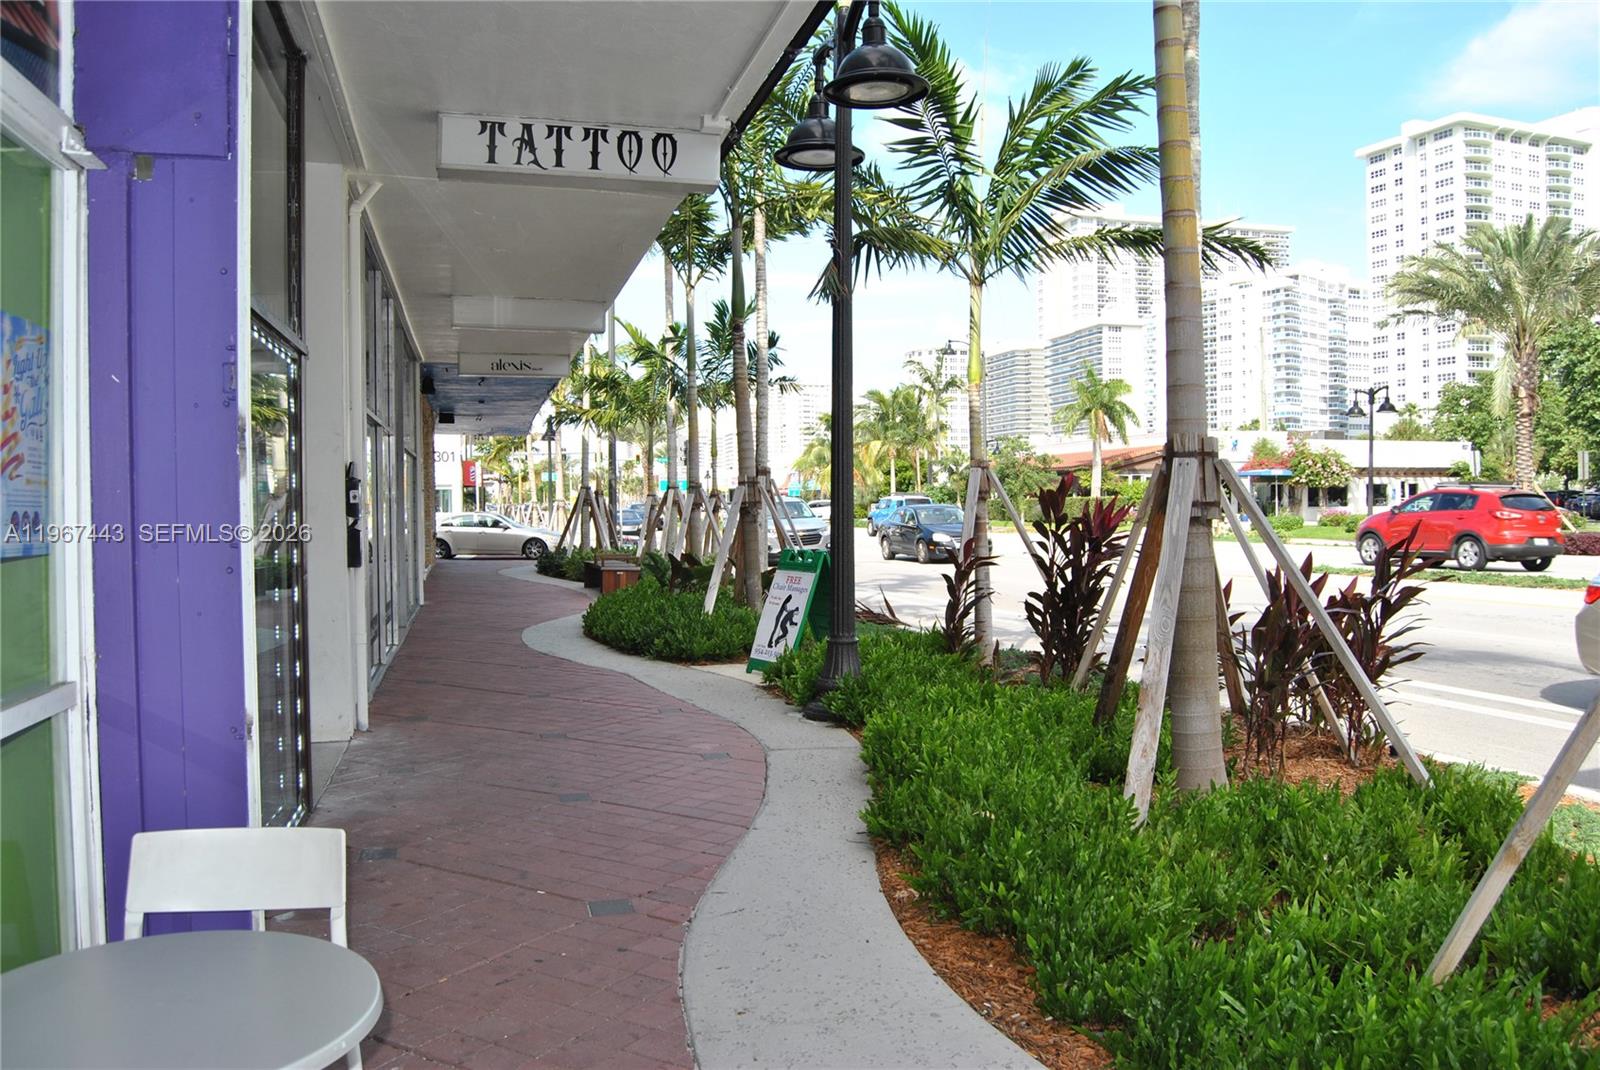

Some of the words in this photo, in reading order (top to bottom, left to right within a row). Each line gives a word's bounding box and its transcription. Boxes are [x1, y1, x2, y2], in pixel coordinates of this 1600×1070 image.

[477, 120, 678, 177] TATTOO
[490, 358, 532, 371] alexis
[785, 575, 803, 585] FREE
